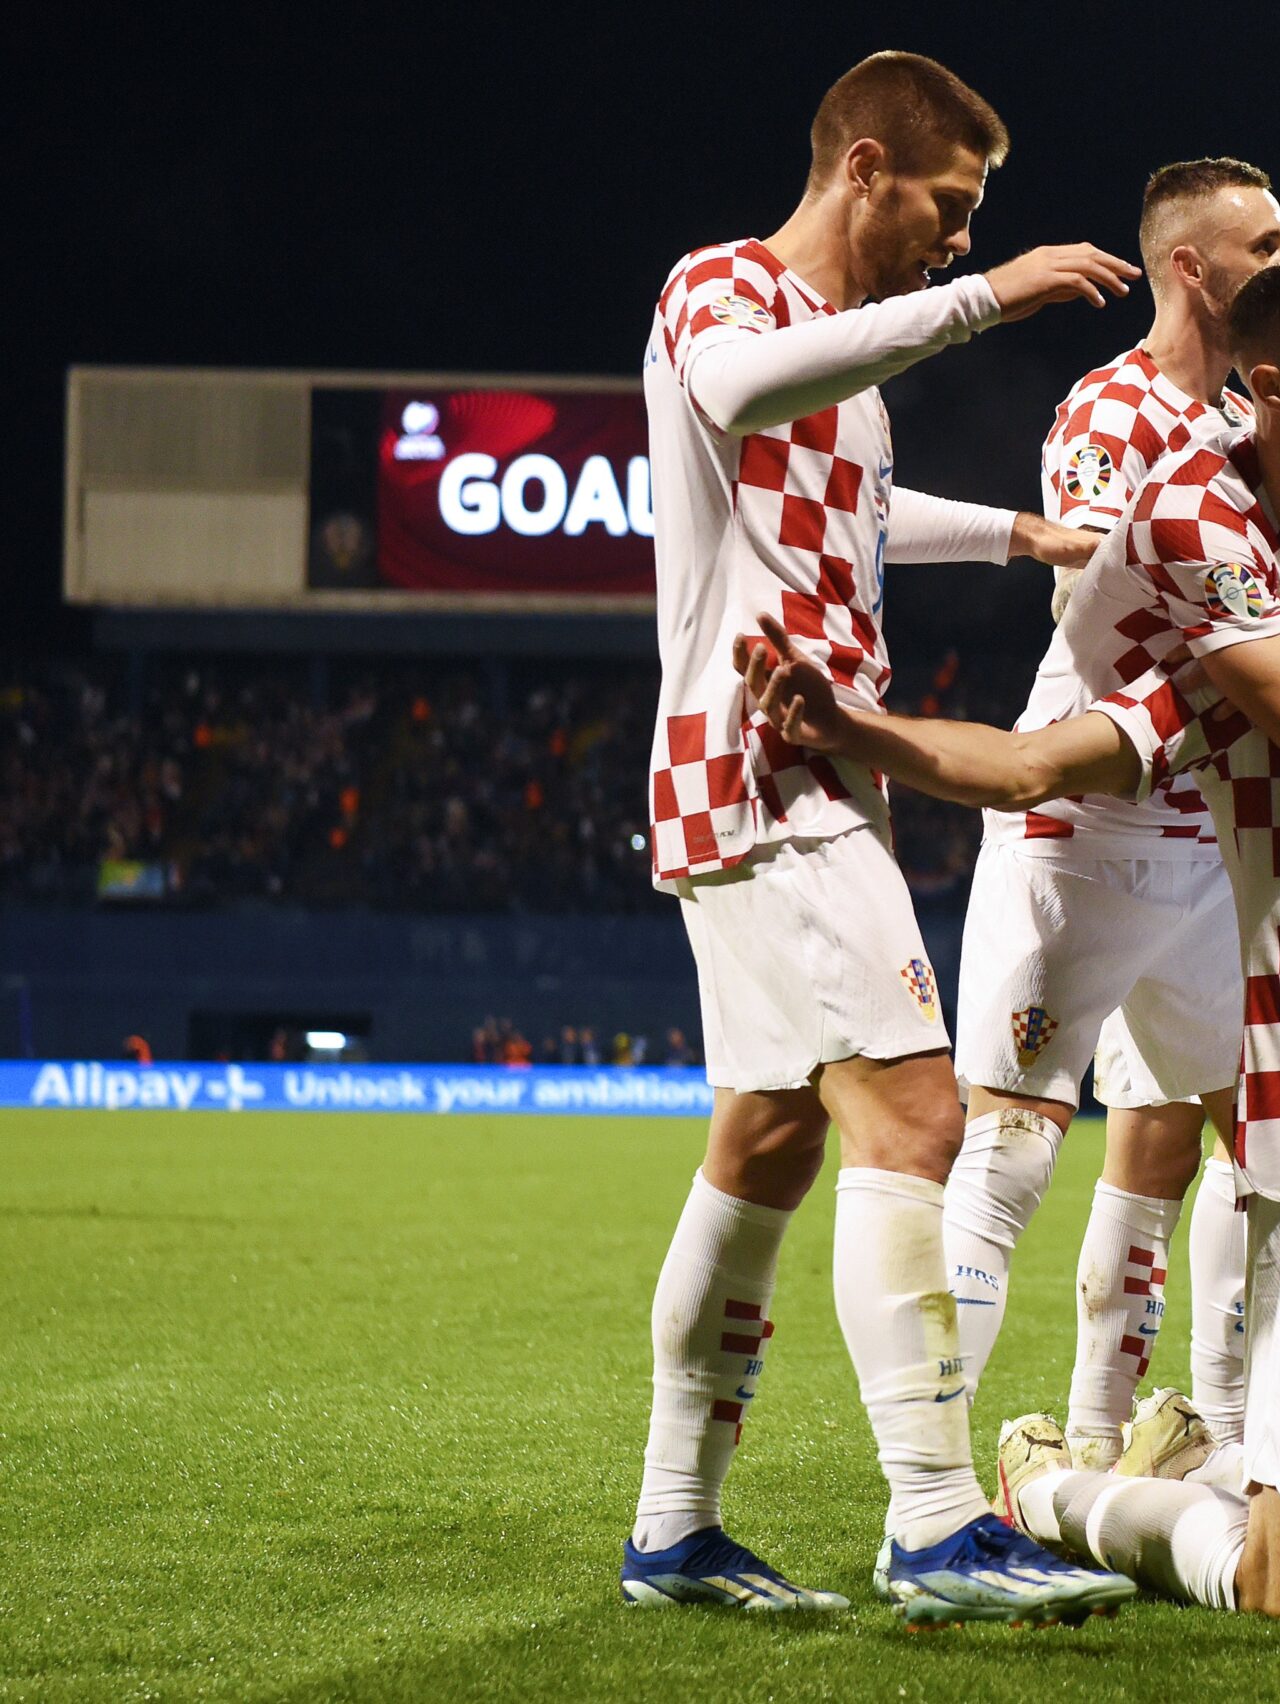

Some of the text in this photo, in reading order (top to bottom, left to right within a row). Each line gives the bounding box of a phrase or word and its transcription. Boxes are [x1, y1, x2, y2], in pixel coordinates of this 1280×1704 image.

[438, 452, 655, 537] GOAL
[283, 1070, 426, 1106] Unlock
[434, 1078, 526, 1112] your
